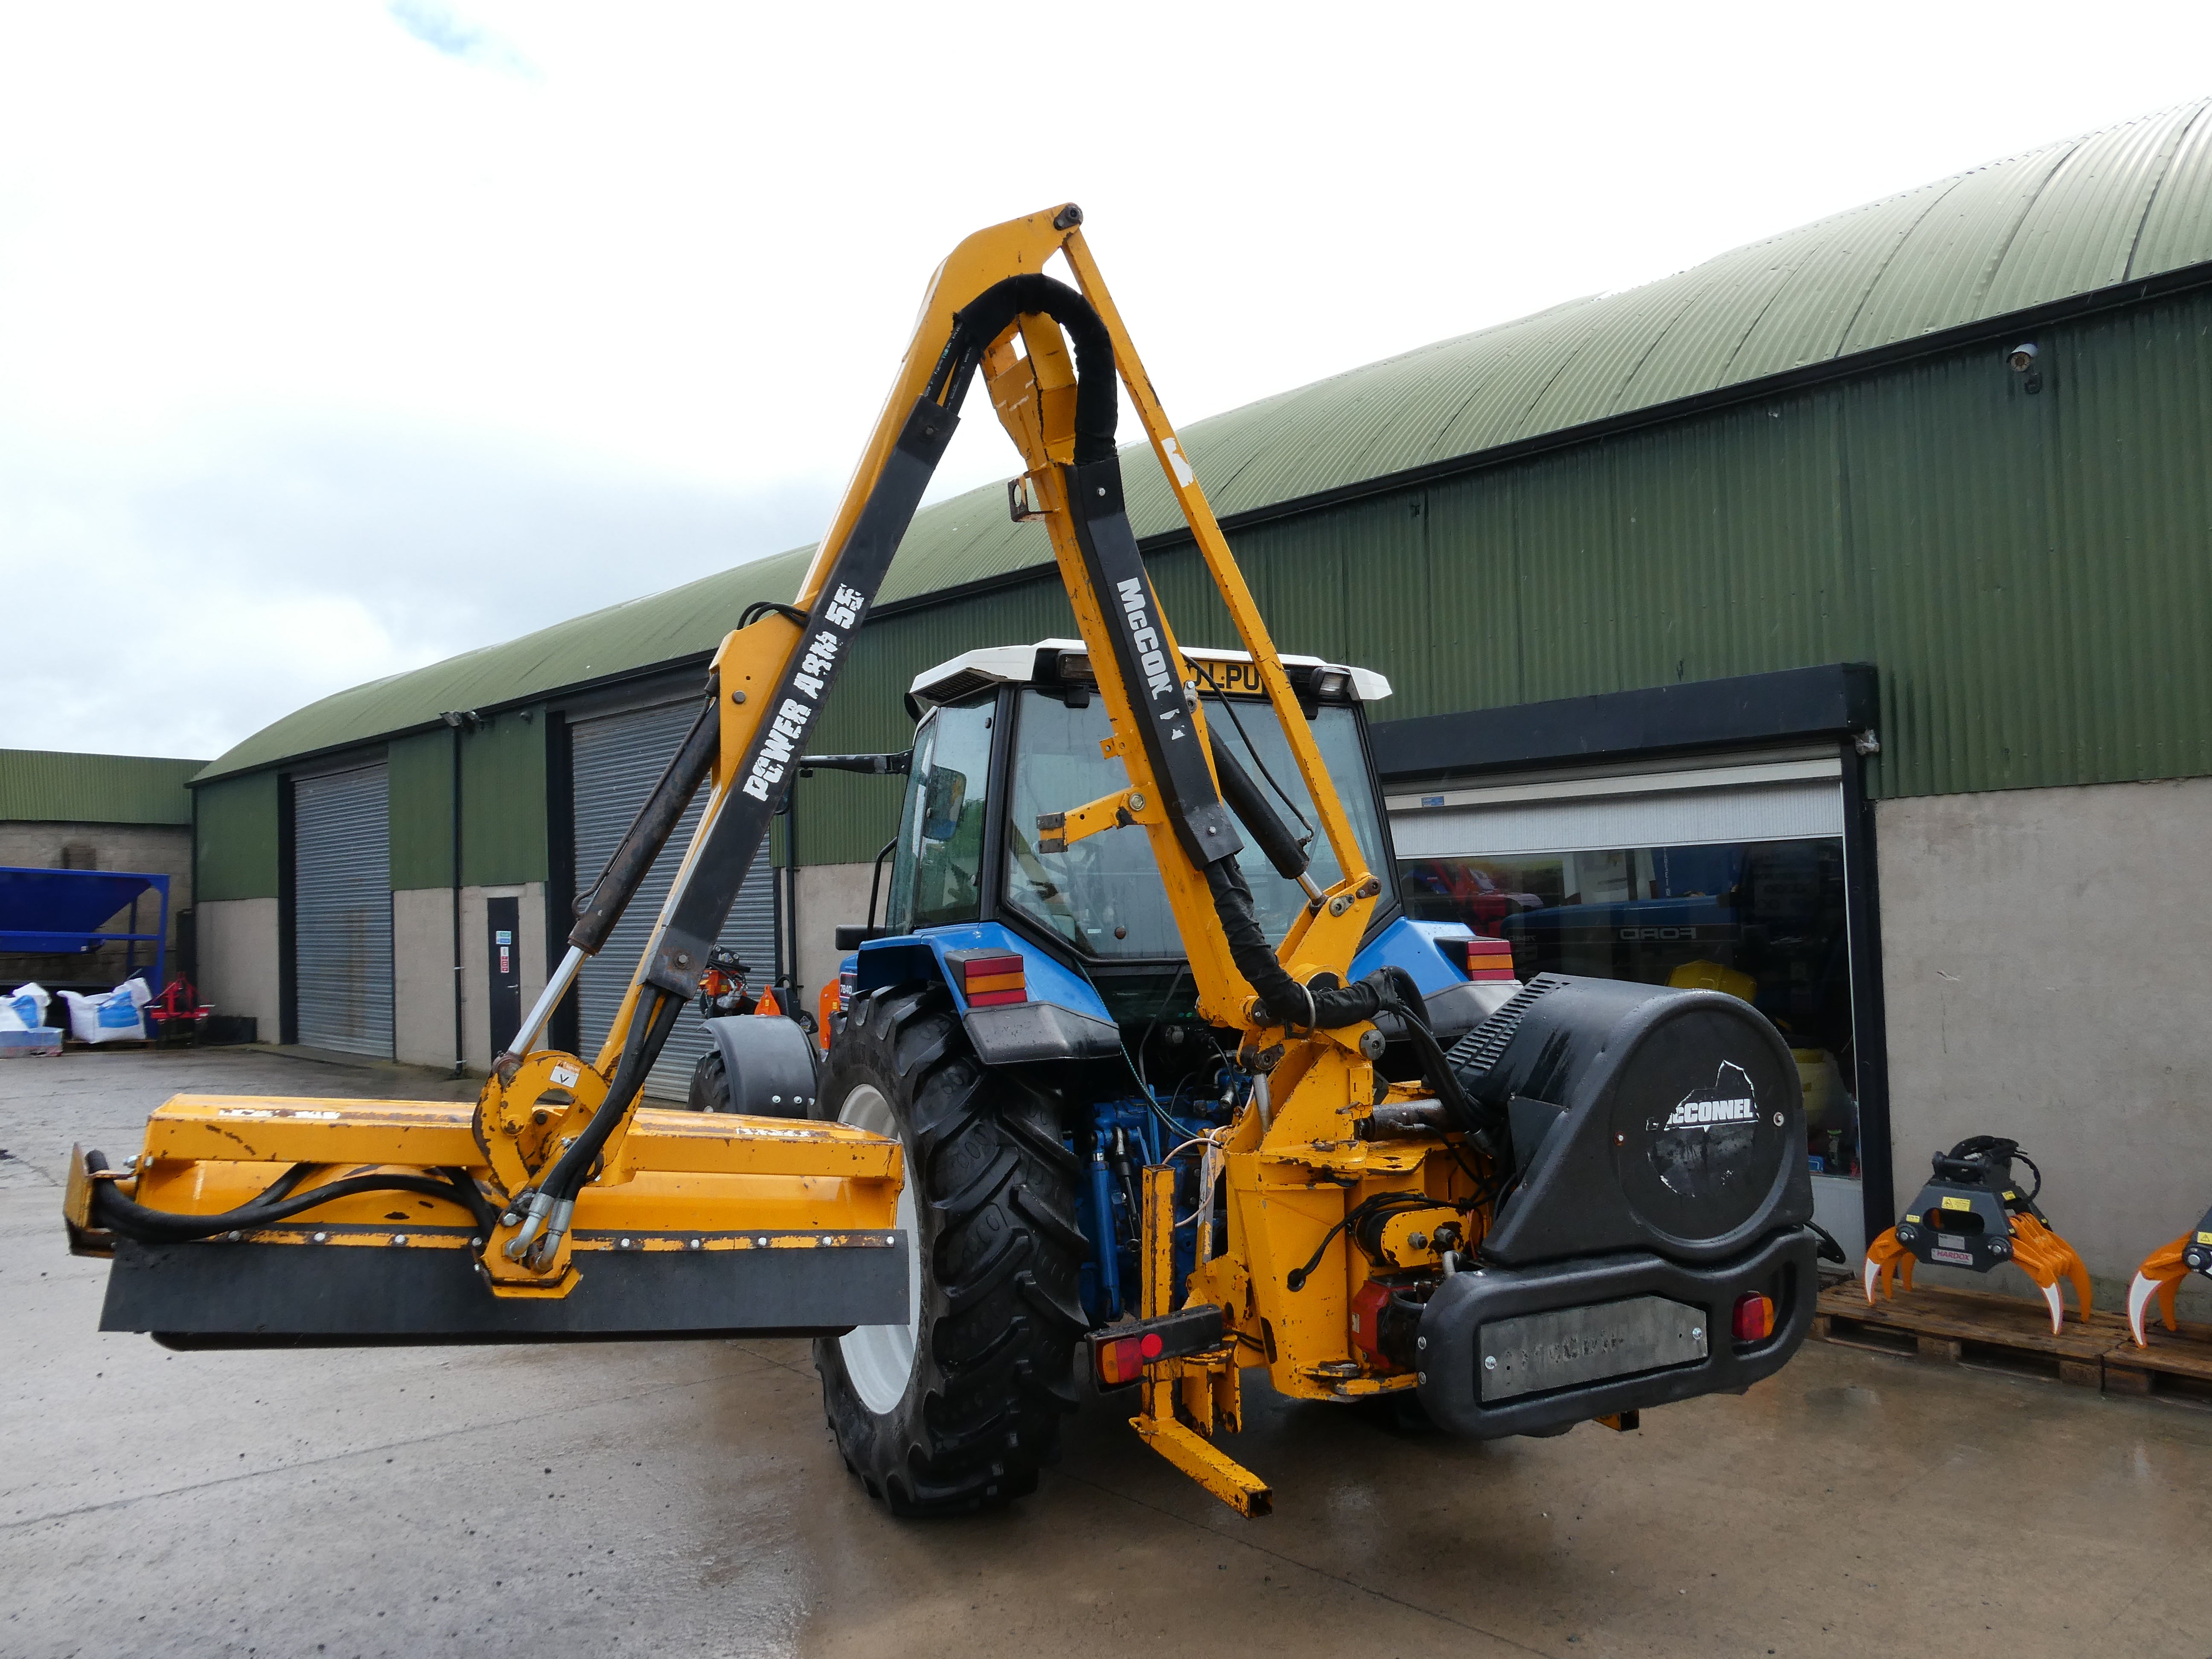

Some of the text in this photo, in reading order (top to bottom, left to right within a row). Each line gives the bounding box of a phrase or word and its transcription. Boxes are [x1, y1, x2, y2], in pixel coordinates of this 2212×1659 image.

[840, 984, 852, 995] 7840
[1667, 1098, 1753, 1124] cCONNEL
[1937, 1251, 1970, 1261] HARDOX
